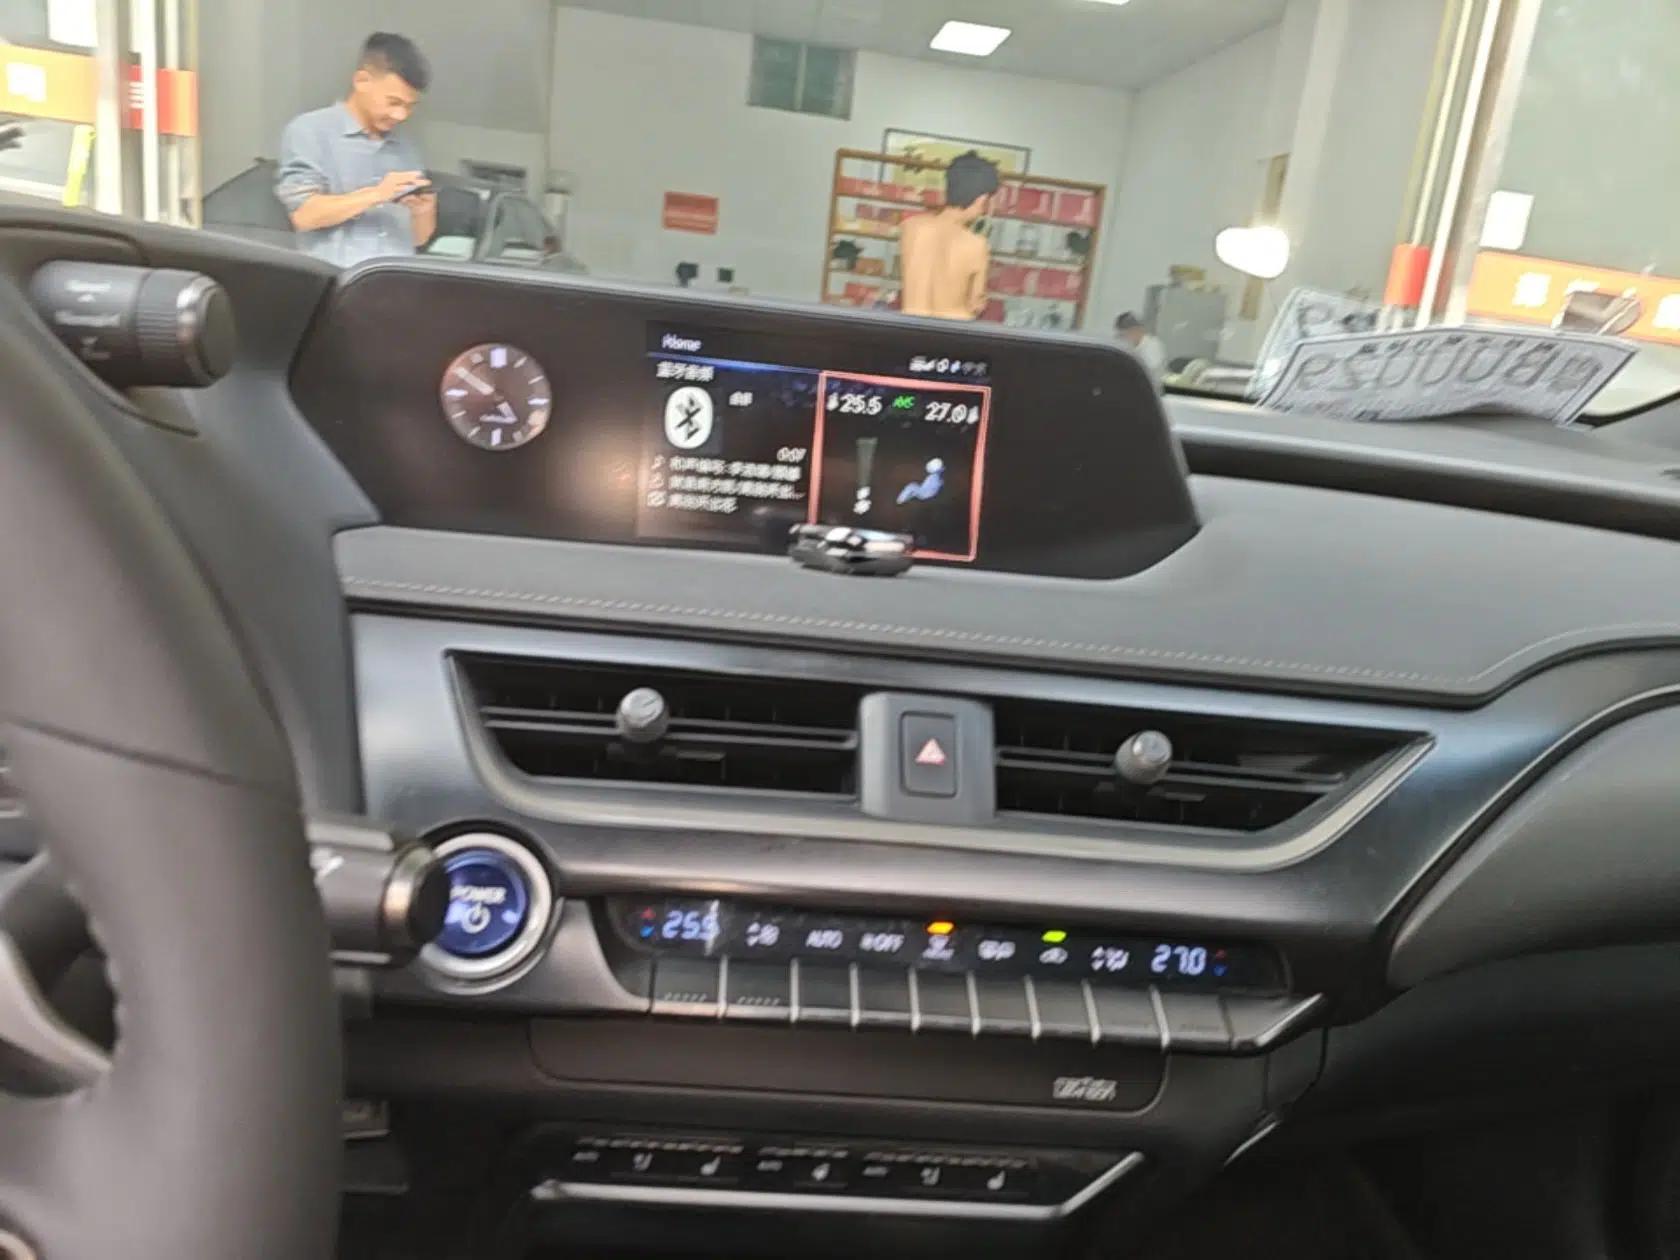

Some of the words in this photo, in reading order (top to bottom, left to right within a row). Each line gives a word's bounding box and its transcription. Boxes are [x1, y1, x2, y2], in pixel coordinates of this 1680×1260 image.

[661, 333, 702, 352] Home
[840, 394, 882, 415] 25.5
[925, 402, 966, 423] 27.0
[450, 885, 507, 904] POWER
